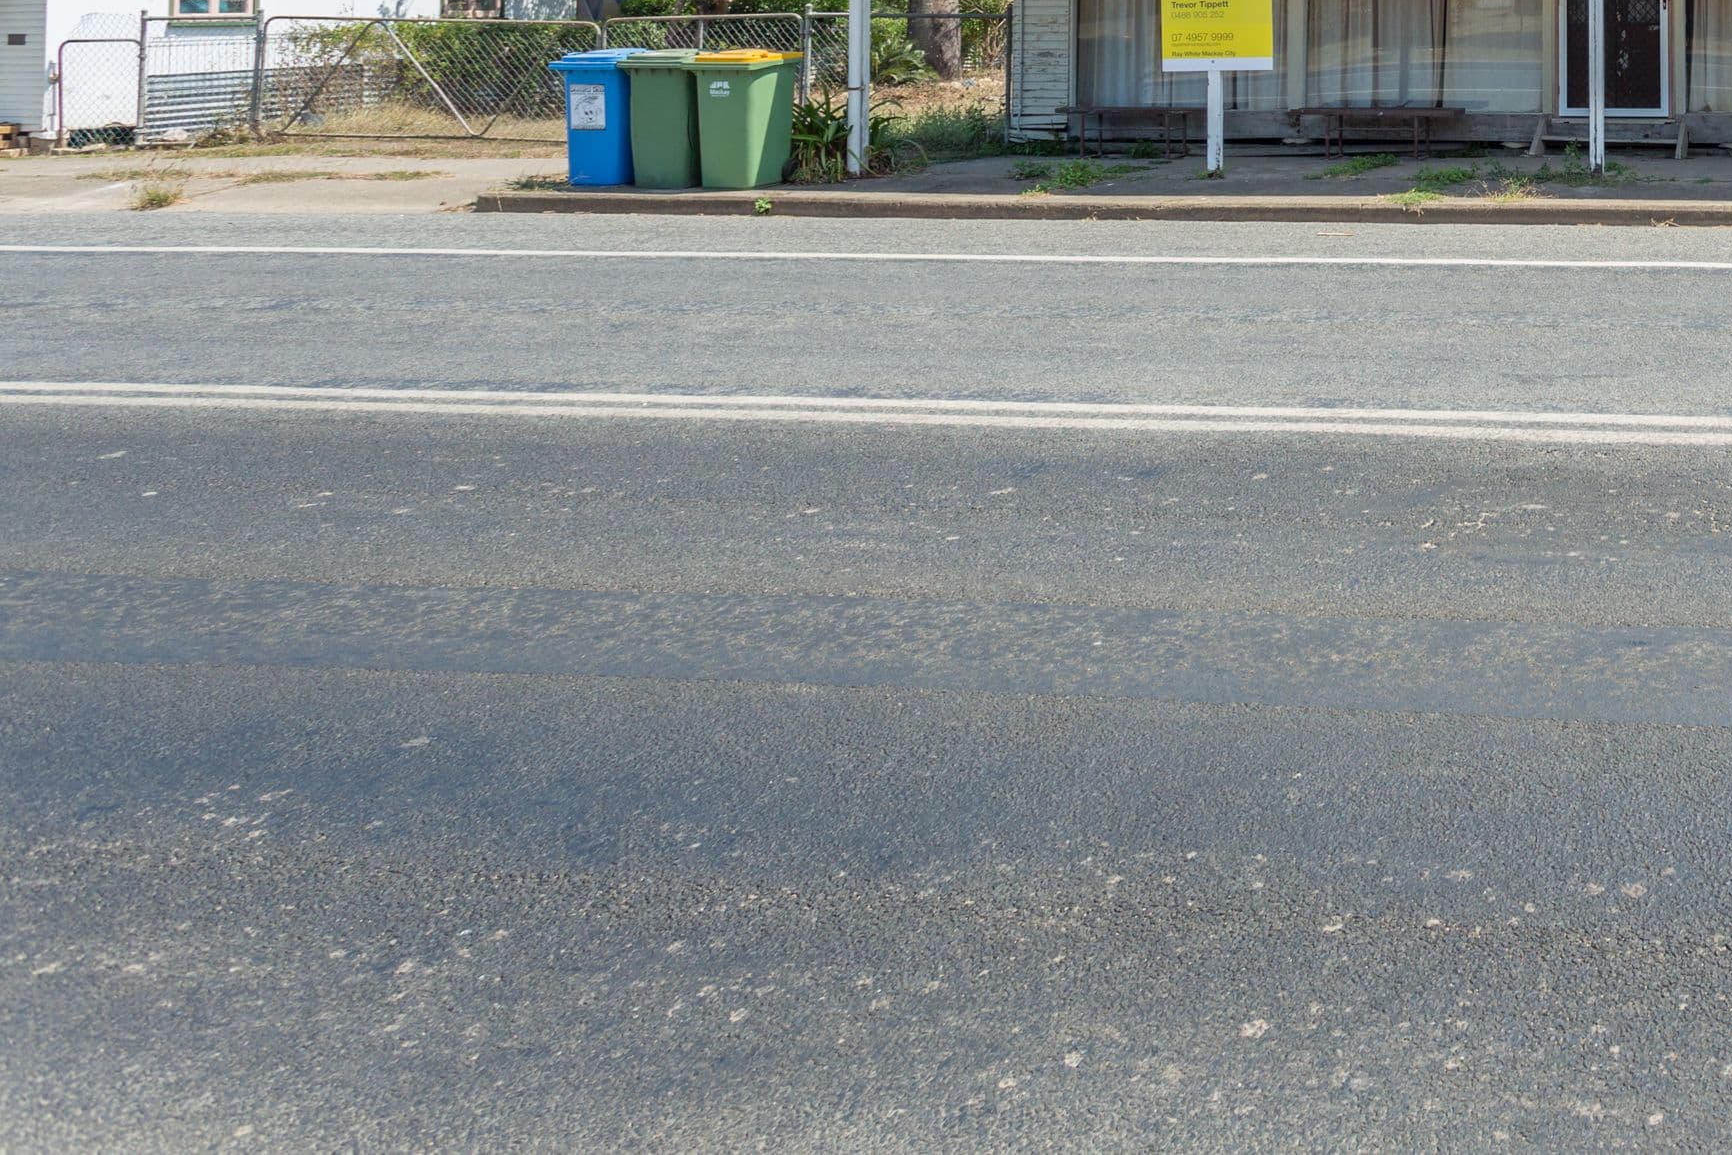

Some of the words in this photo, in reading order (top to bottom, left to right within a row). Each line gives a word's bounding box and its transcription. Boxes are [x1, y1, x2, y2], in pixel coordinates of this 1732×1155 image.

[1171, 1, 1197, 9] Trevor
[1200, 0, 1229, 9] Tippett
[1171, 33, 1183, 42] 07
[1185, 32, 1208, 41] 4957
[1211, 32, 1234, 41] 9999
